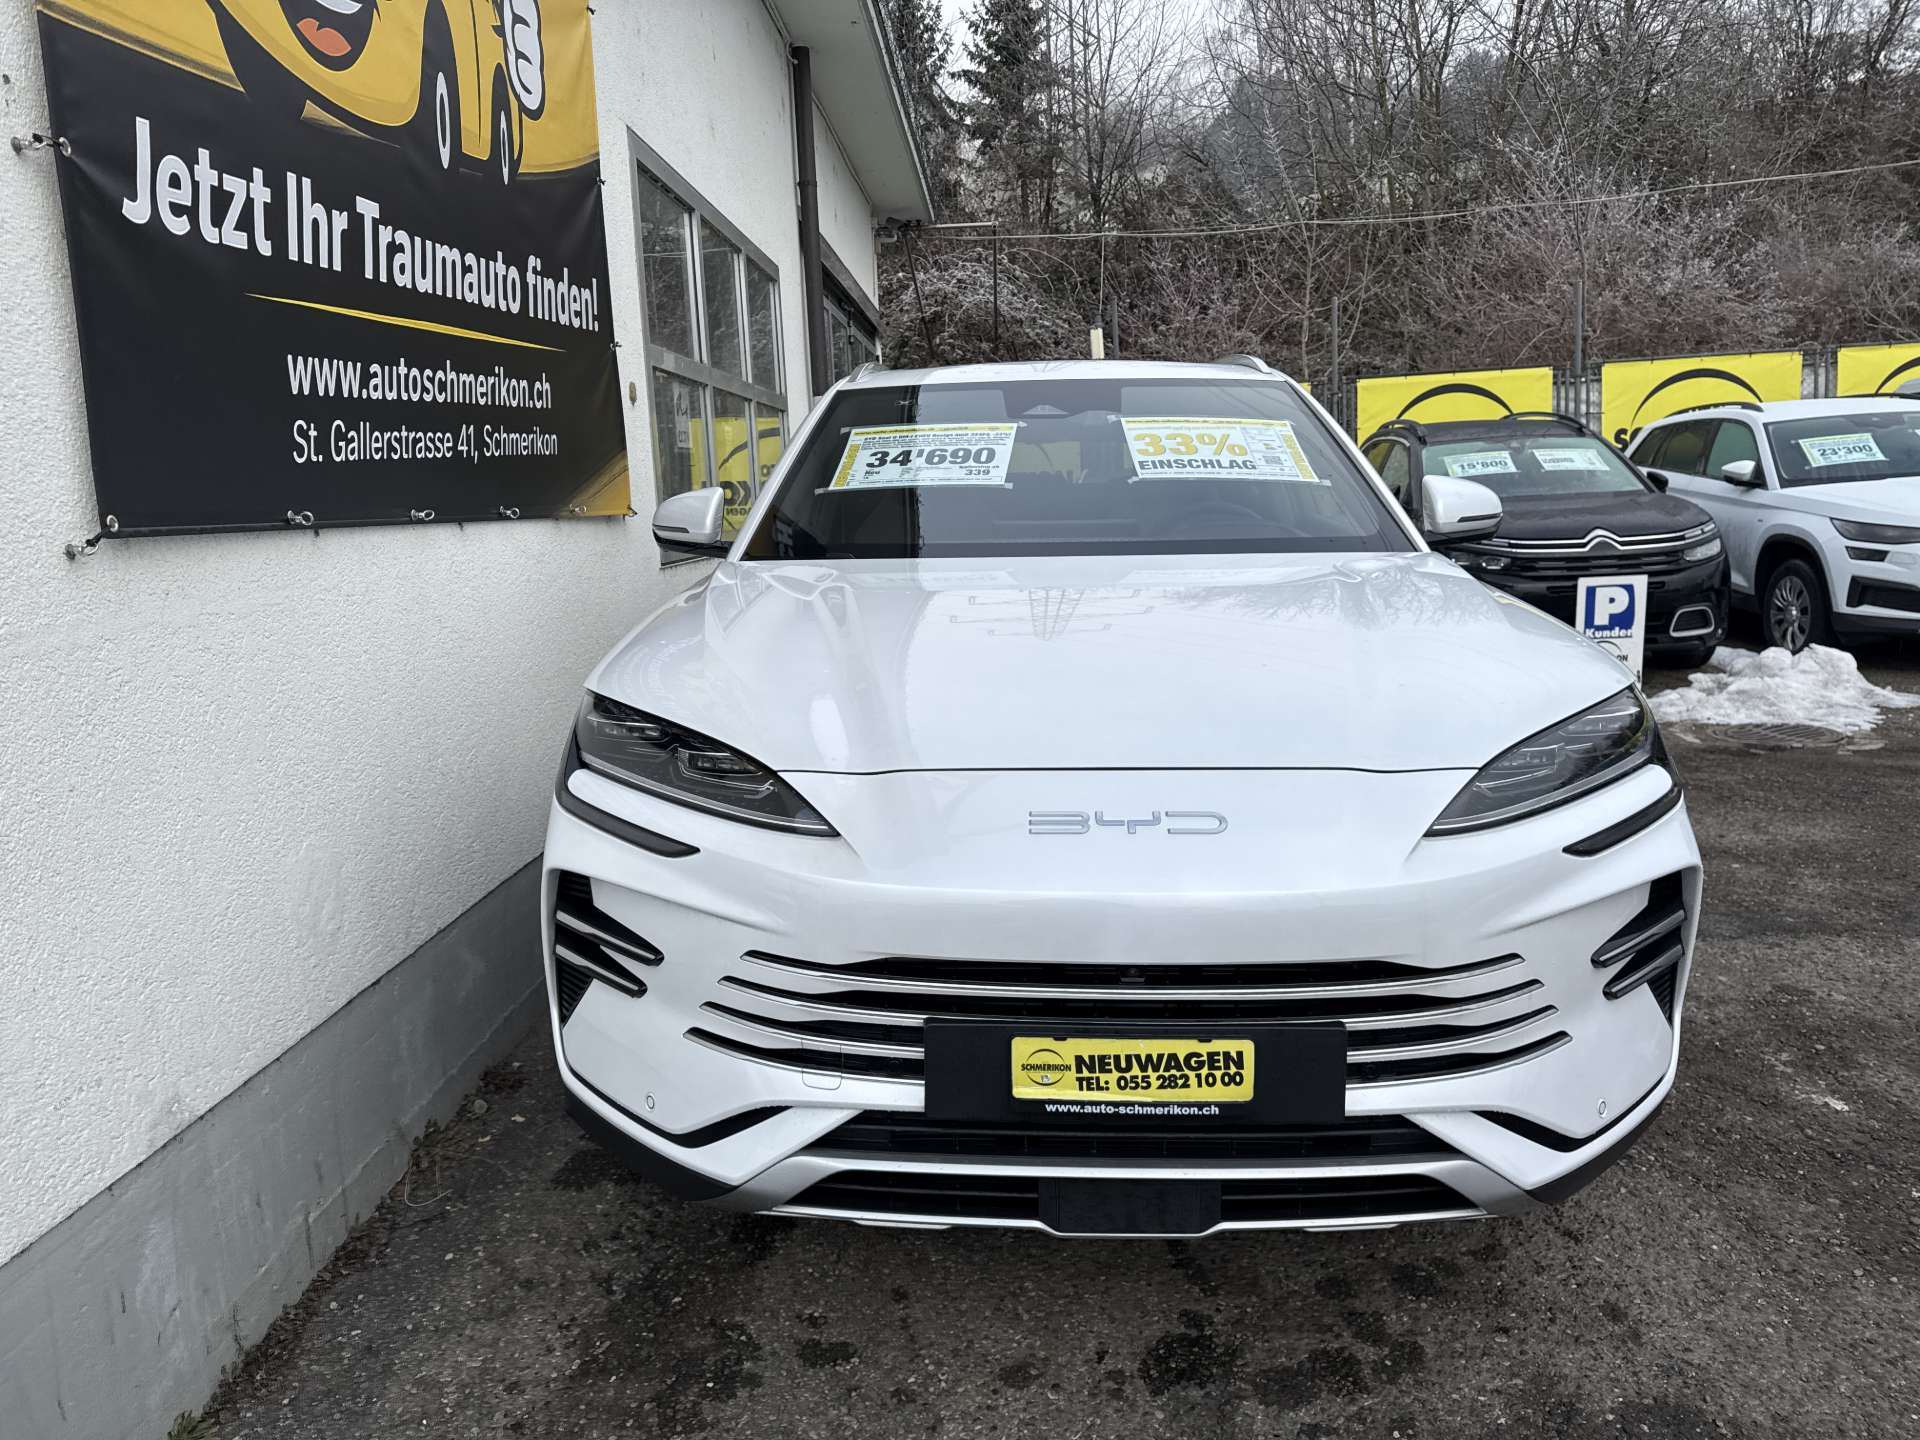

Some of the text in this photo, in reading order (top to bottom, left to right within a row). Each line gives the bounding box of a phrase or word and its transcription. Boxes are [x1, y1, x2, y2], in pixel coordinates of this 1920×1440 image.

[121, 116, 600, 332] Jetzt Ihr Traumauto finden!
[287, 353, 552, 409] www.autoschmerikon.ch
[292, 420, 558, 464] St. Gallerstrasse 41, Schmerikon
[1133, 432, 1248, 457] 33%
[1817, 444, 1873, 457] 23'300
[866, 447, 996, 468] 34'690
[1138, 458, 1257, 470] EINSCHLAG
[1458, 459, 1508, 471] 15'800
[1593, 586, 1629, 626] P
[1029, 811, 1228, 834] BYD
[1021, 1063, 1072, 1072] SCHMERIKON
[1074, 1050, 1245, 1075] NEUWAGEN
[1076, 1071, 1245, 1092] TEL: 055 282 10 00
[1045, 1102, 1220, 1116] www.auto-schmerikon.ch
